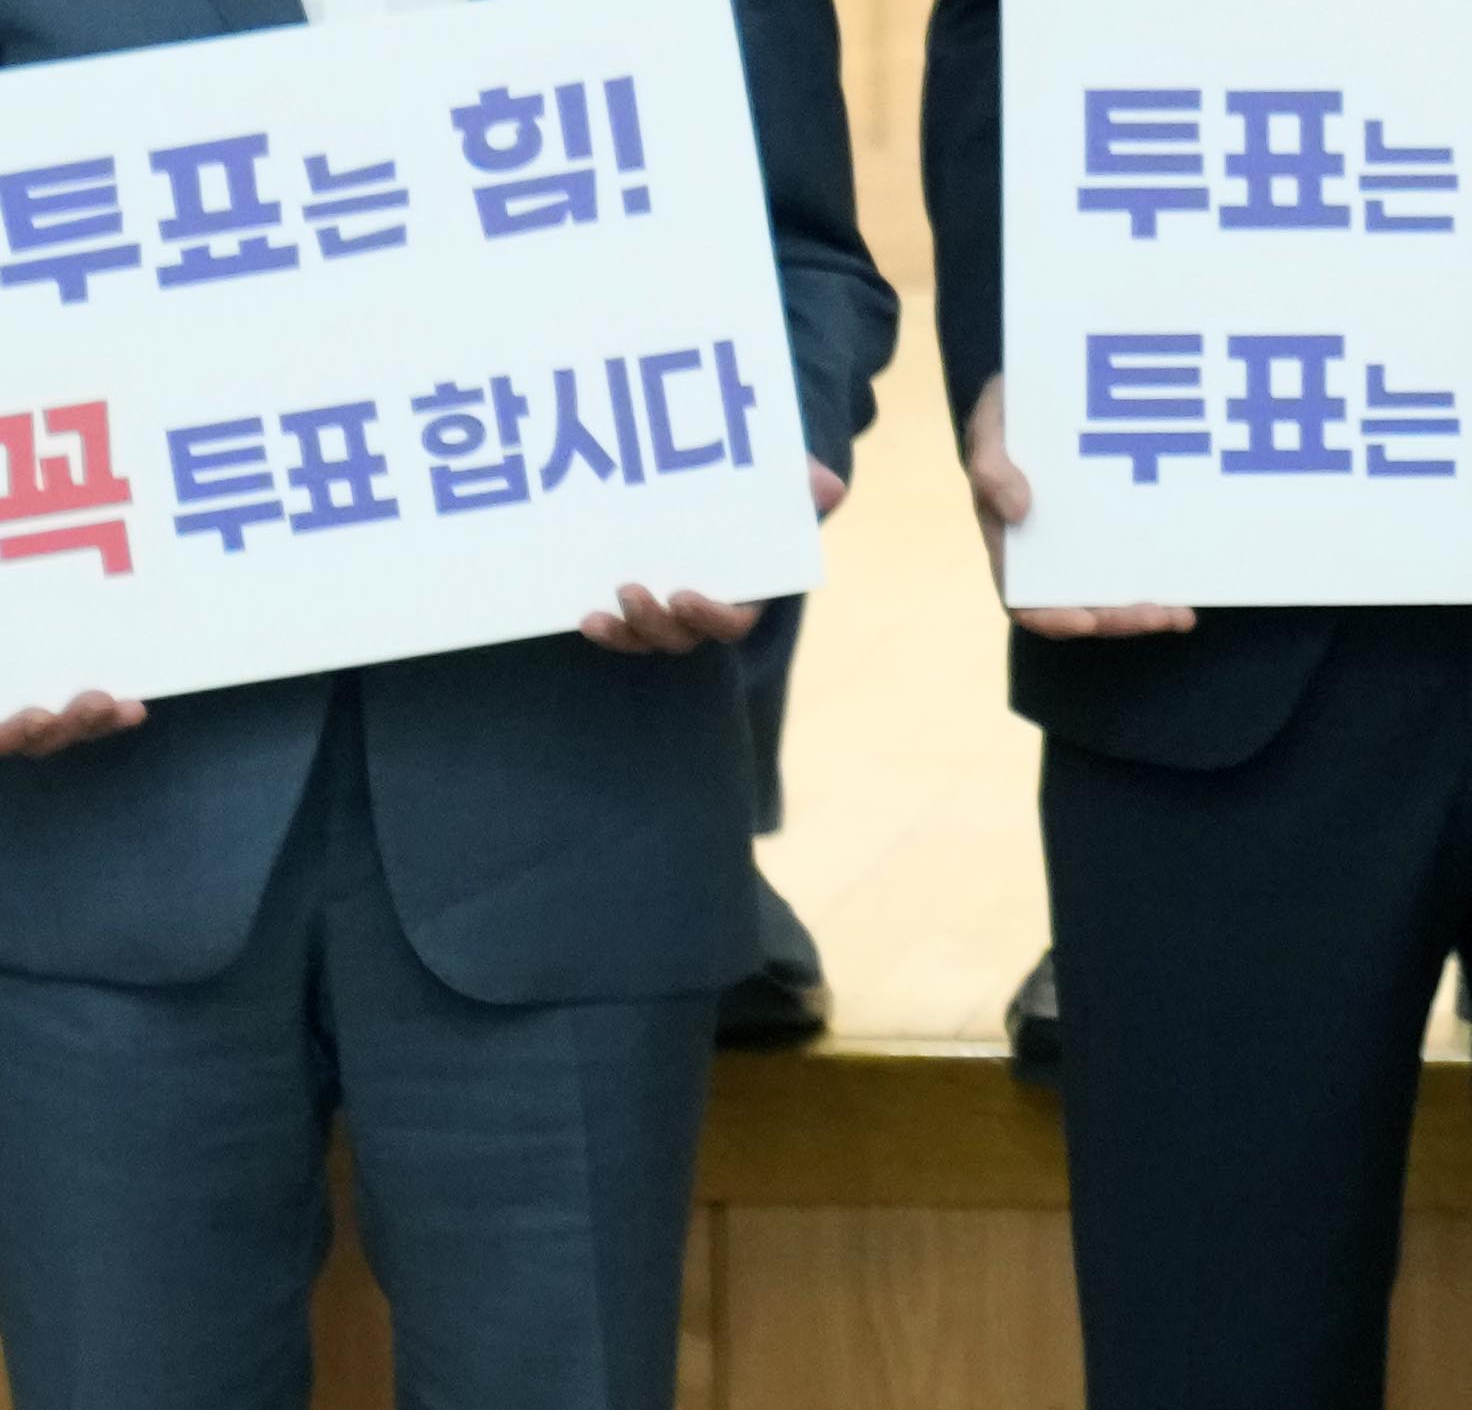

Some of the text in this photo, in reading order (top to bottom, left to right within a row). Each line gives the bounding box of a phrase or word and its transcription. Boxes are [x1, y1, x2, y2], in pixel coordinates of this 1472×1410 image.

[0, 75, 651, 305] 투표는 힘!
[1077, 88, 1458, 240] 투표는
[0, 340, 756, 577] 꼭 투표 합시다
[1079, 333, 1460, 484] 투표는
